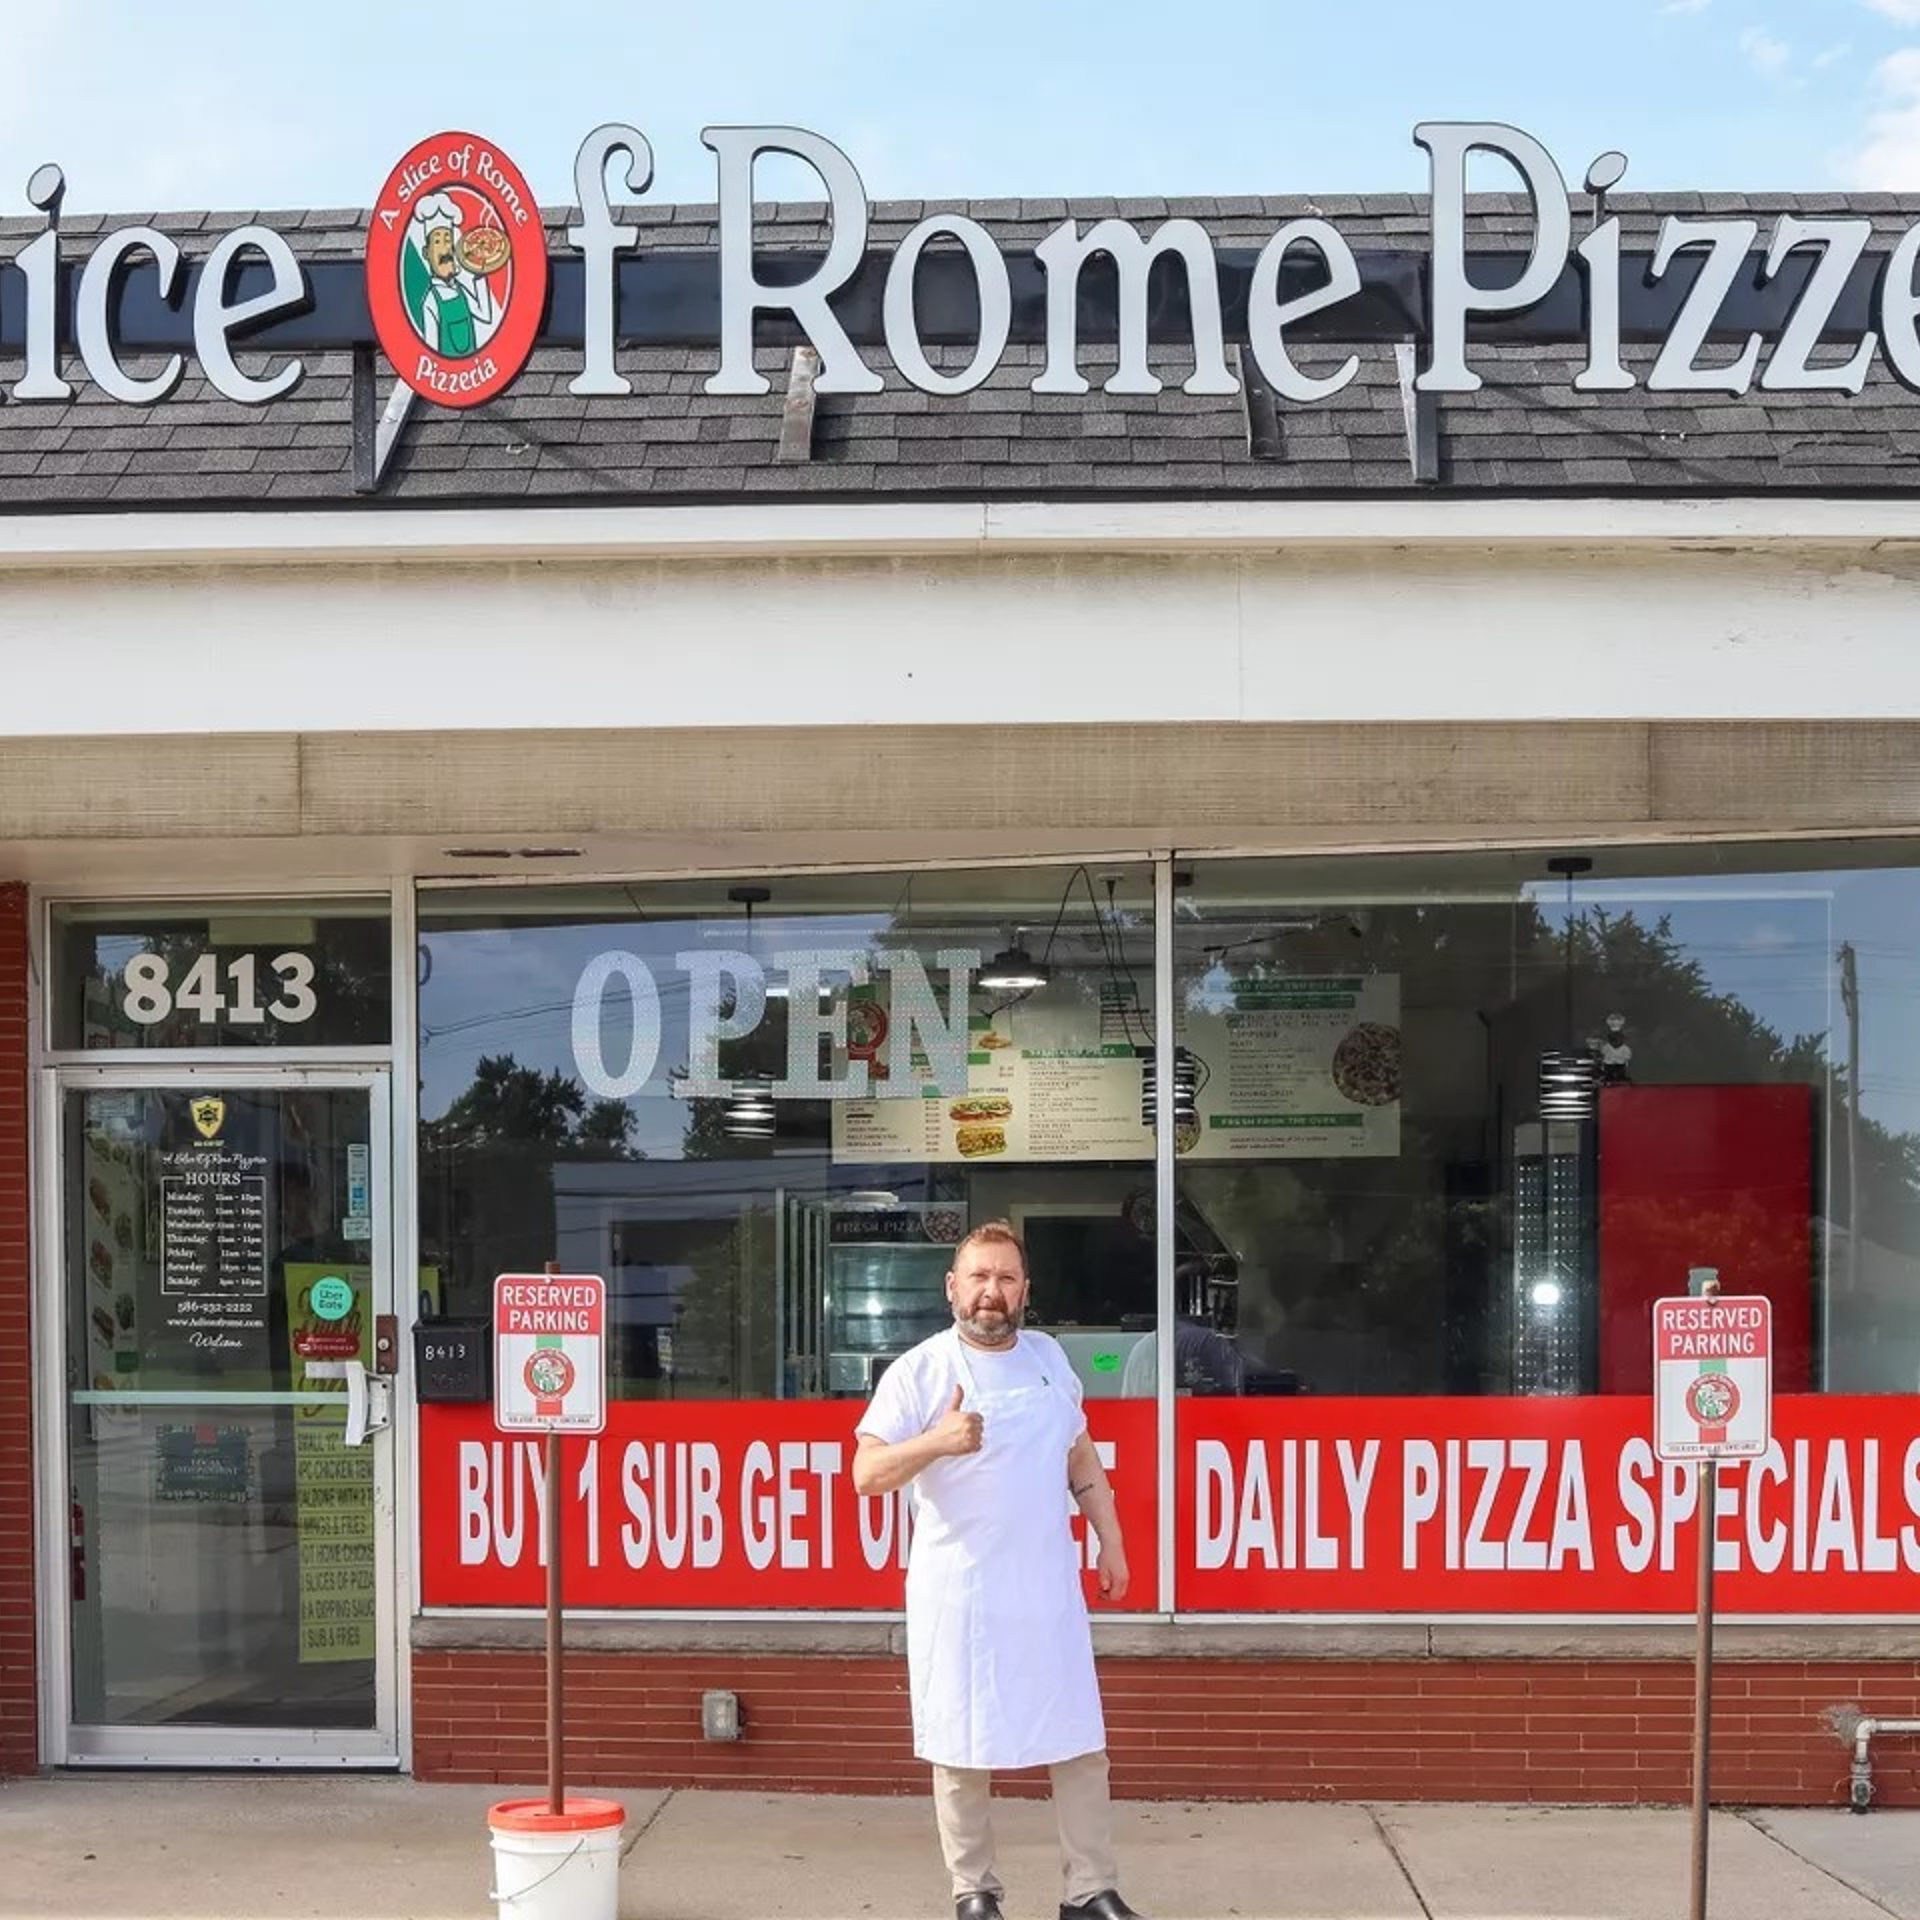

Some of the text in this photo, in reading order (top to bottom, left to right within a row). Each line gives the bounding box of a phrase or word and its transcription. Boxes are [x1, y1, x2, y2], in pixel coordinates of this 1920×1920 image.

[379, 142, 530, 231] A slice of Rome
[0, 162, 305, 402] ice
[700, 124, 1363, 401] Rome
[416, 354, 498, 394] Pizzeria
[123, 952, 318, 1025] 8413
[571, 948, 982, 1100] OPEN
[185, 1172, 241, 1185] HOURS
[319, 1299, 343, 1309] Eats
[320, 1289, 343, 1300] Uber
[503, 1285, 597, 1307] RESERVED
[509, 1310, 590, 1331] PARKING
[1662, 1307, 1763, 1331] RESERVED
[425, 1343, 466, 1361] 8413
[1670, 1332, 1756, 1355] PARKING
[459, 1440, 548, 1567] BUY
[578, 1438, 600, 1568] 1
[621, 1440, 724, 1571] SUB
[740, 1440, 842, 1571] GET
[1194, 1438, 1381, 1571] DAILY
[1402, 1438, 1595, 1571] PIZZA
[1614, 1436, 1920, 1574] SPECIALS
[305, 1571, 336, 1592] SLICES
[337, 1571, 349, 1590] OF
[352, 1599, 375, 1617] SAUC
[337, 1626, 360, 1646] FRIES
